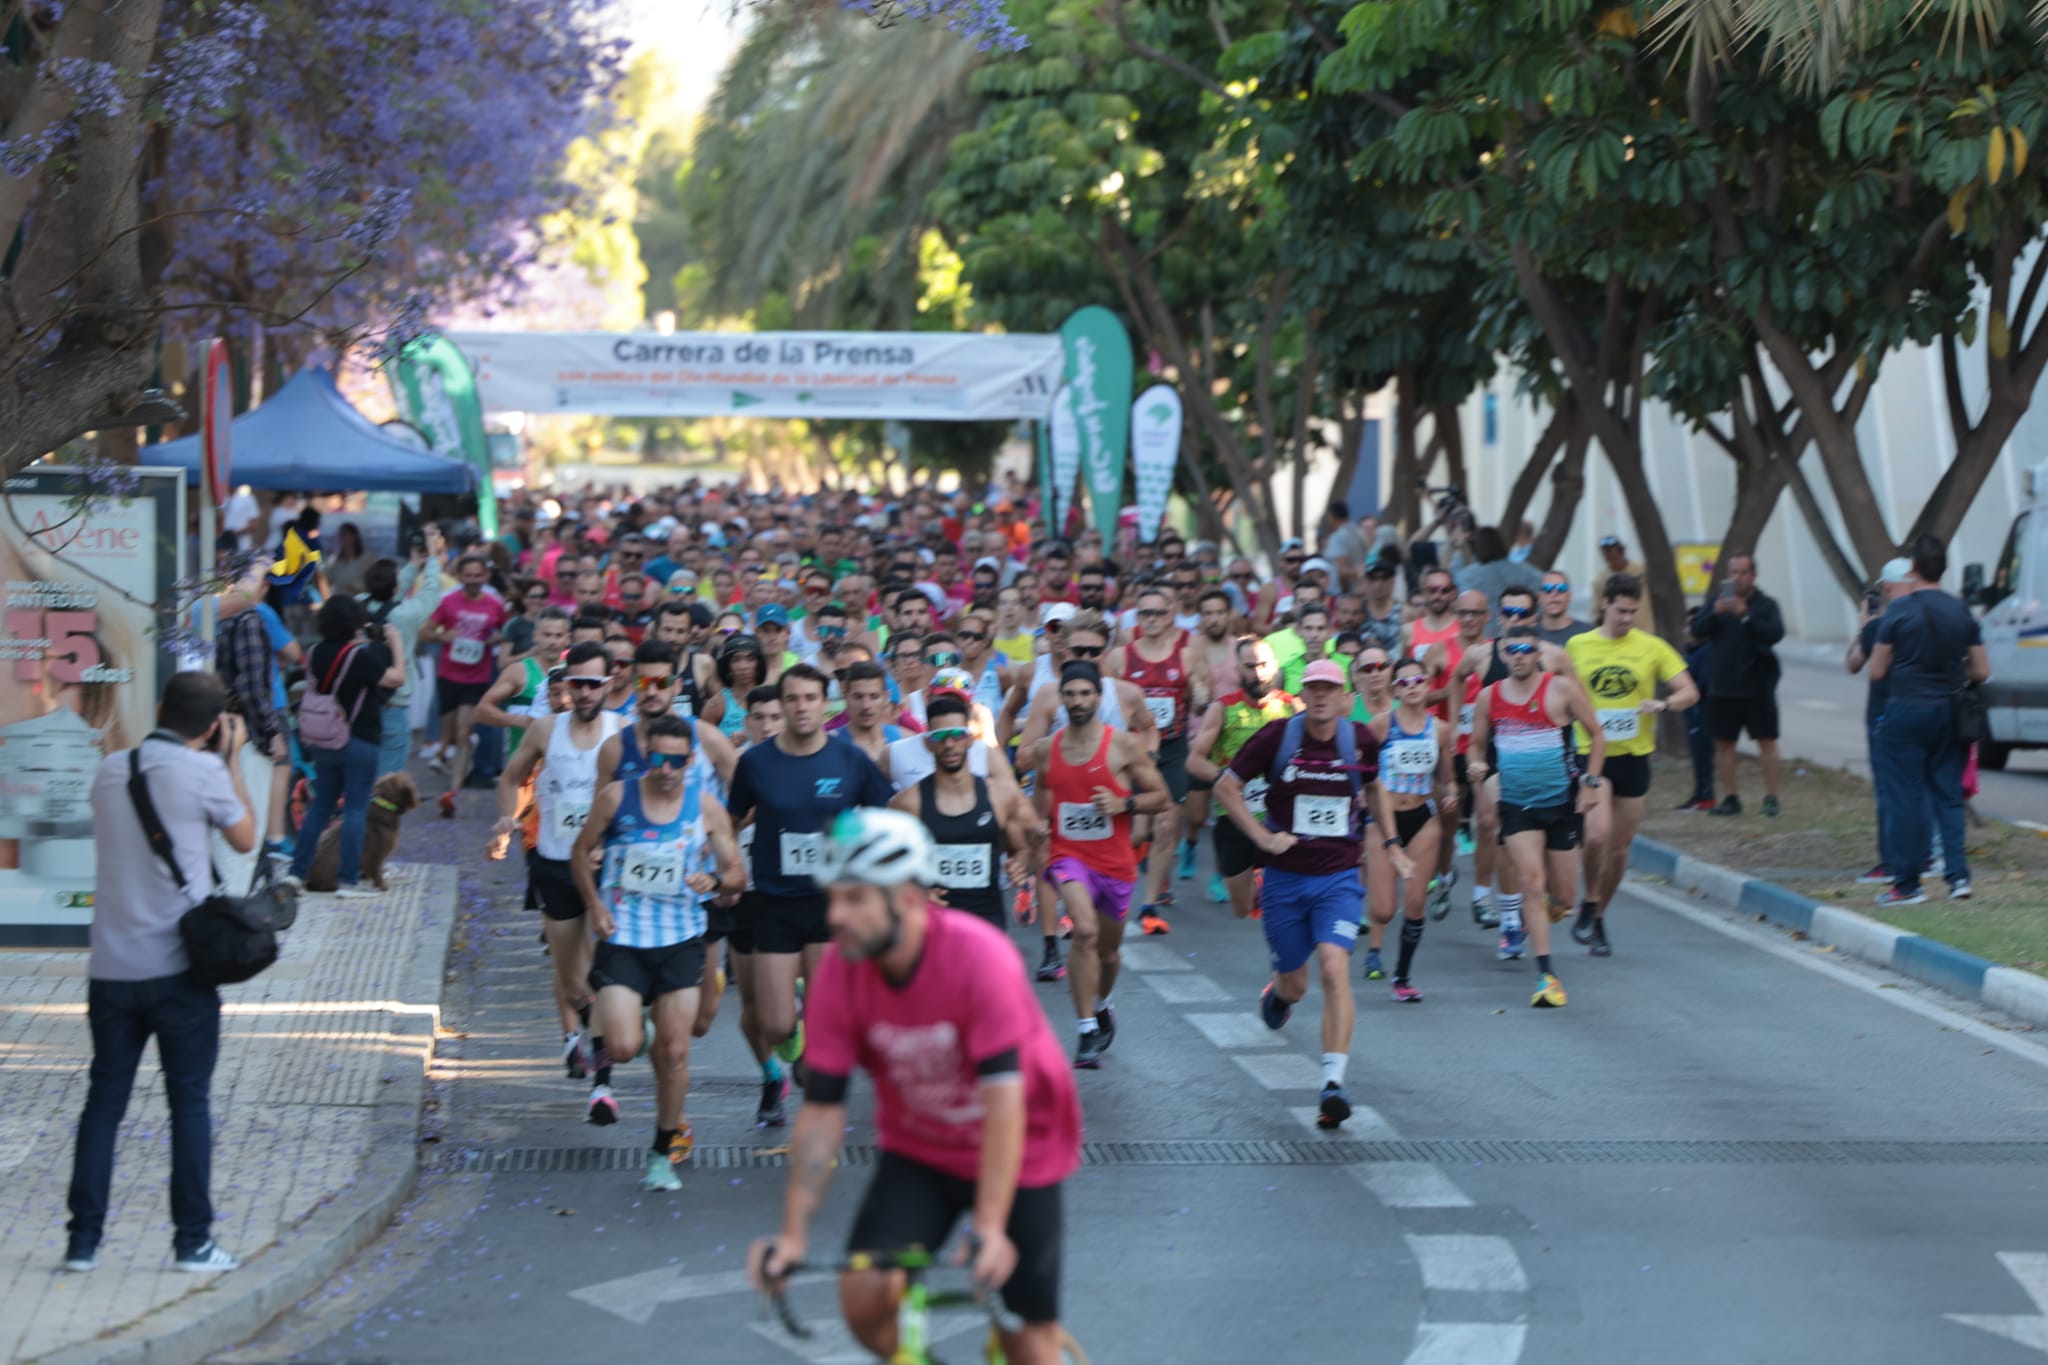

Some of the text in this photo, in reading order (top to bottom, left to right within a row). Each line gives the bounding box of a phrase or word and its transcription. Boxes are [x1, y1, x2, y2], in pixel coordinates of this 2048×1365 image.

[612, 338, 914, 365] Carrera de la Prensa
[5, 610, 102, 682] 15
[1307, 808, 1336, 826] 28
[629, 864, 675, 883] 471
[937, 859, 985, 876] 668
